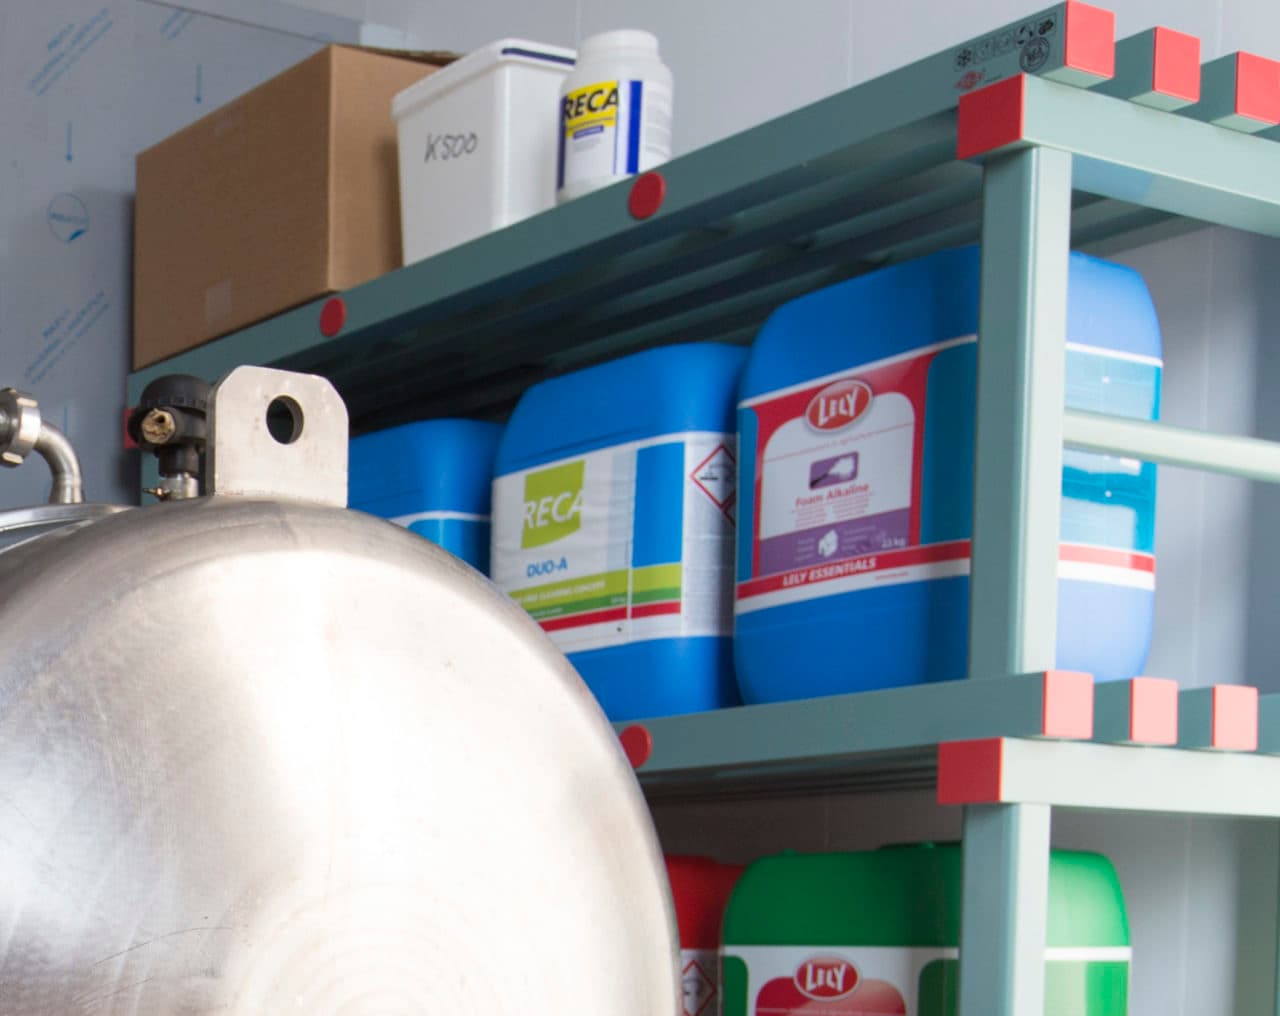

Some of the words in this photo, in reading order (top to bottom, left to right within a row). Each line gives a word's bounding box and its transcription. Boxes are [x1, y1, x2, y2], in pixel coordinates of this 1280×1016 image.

[562, 88, 619, 120] RECA
[424, 132, 478, 163] K500
[818, 387, 860, 426] LELY
[523, 490, 585, 529] RECA
[796, 494, 824, 507] Foam
[827, 483, 870, 501] Alkaline
[526, 557, 568, 578] DUO-A
[783, 573, 806, 587] LELY
[808, 558, 877, 581] ESSENTIALS
[805, 963, 846, 993] LELY
